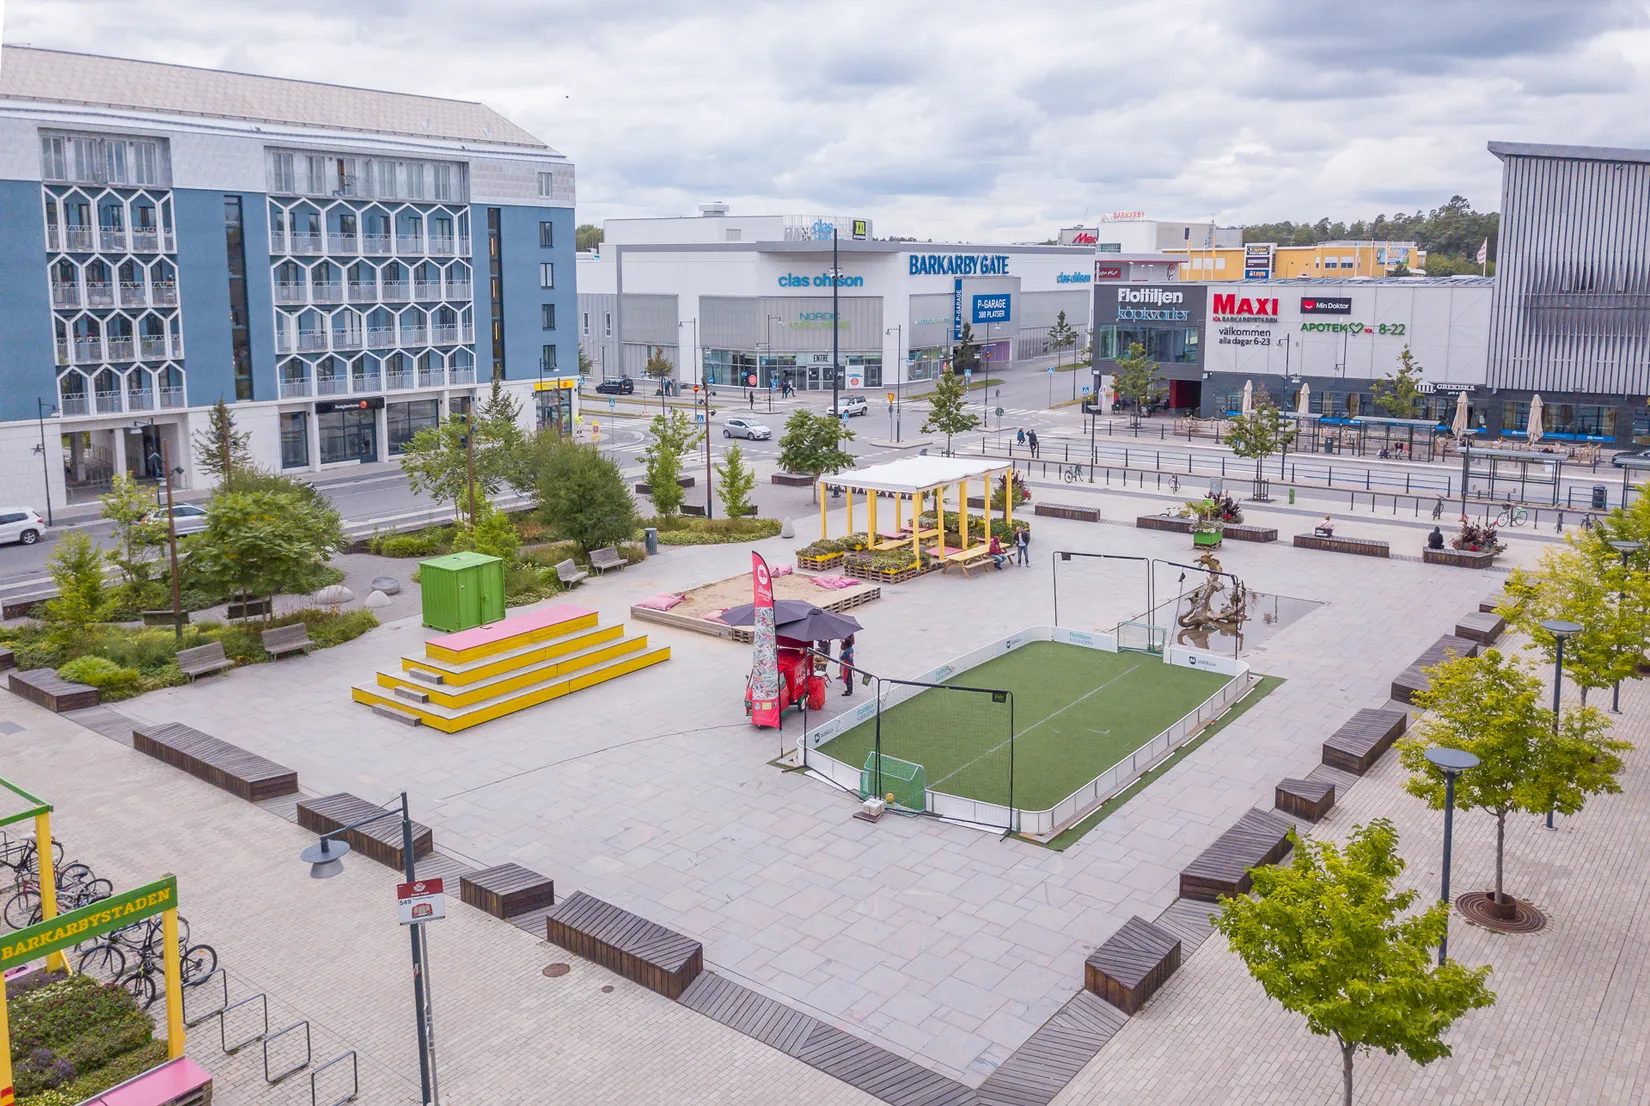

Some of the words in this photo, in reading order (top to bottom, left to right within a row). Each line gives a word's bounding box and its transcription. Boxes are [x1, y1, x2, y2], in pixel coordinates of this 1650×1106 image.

[813, 219, 834, 235] clas
[909, 254, 979, 275] BARKARBY
[980, 255, 1009, 275] GATE
[778, 273, 810, 287] clas
[813, 273, 864, 287] ohson
[977, 299, 1006, 309] P-GARAGE
[1118, 288, 1183, 306] Flottiljen
[1213, 294, 1279, 315] MAXI
[987, 310, 1005, 318] PLATSER
[1117, 306, 1190, 322] köpkvarter
[1219, 327, 1271, 337] välkommen
[1300, 323, 1347, 332] APOTEK
[1379, 323, 1405, 335] 8-22
[1232, 337, 1253, 347] dagar
[1253, 338, 1270, 346] 6-23
[1, 887, 171, 961] BARKARBYSTADEN
